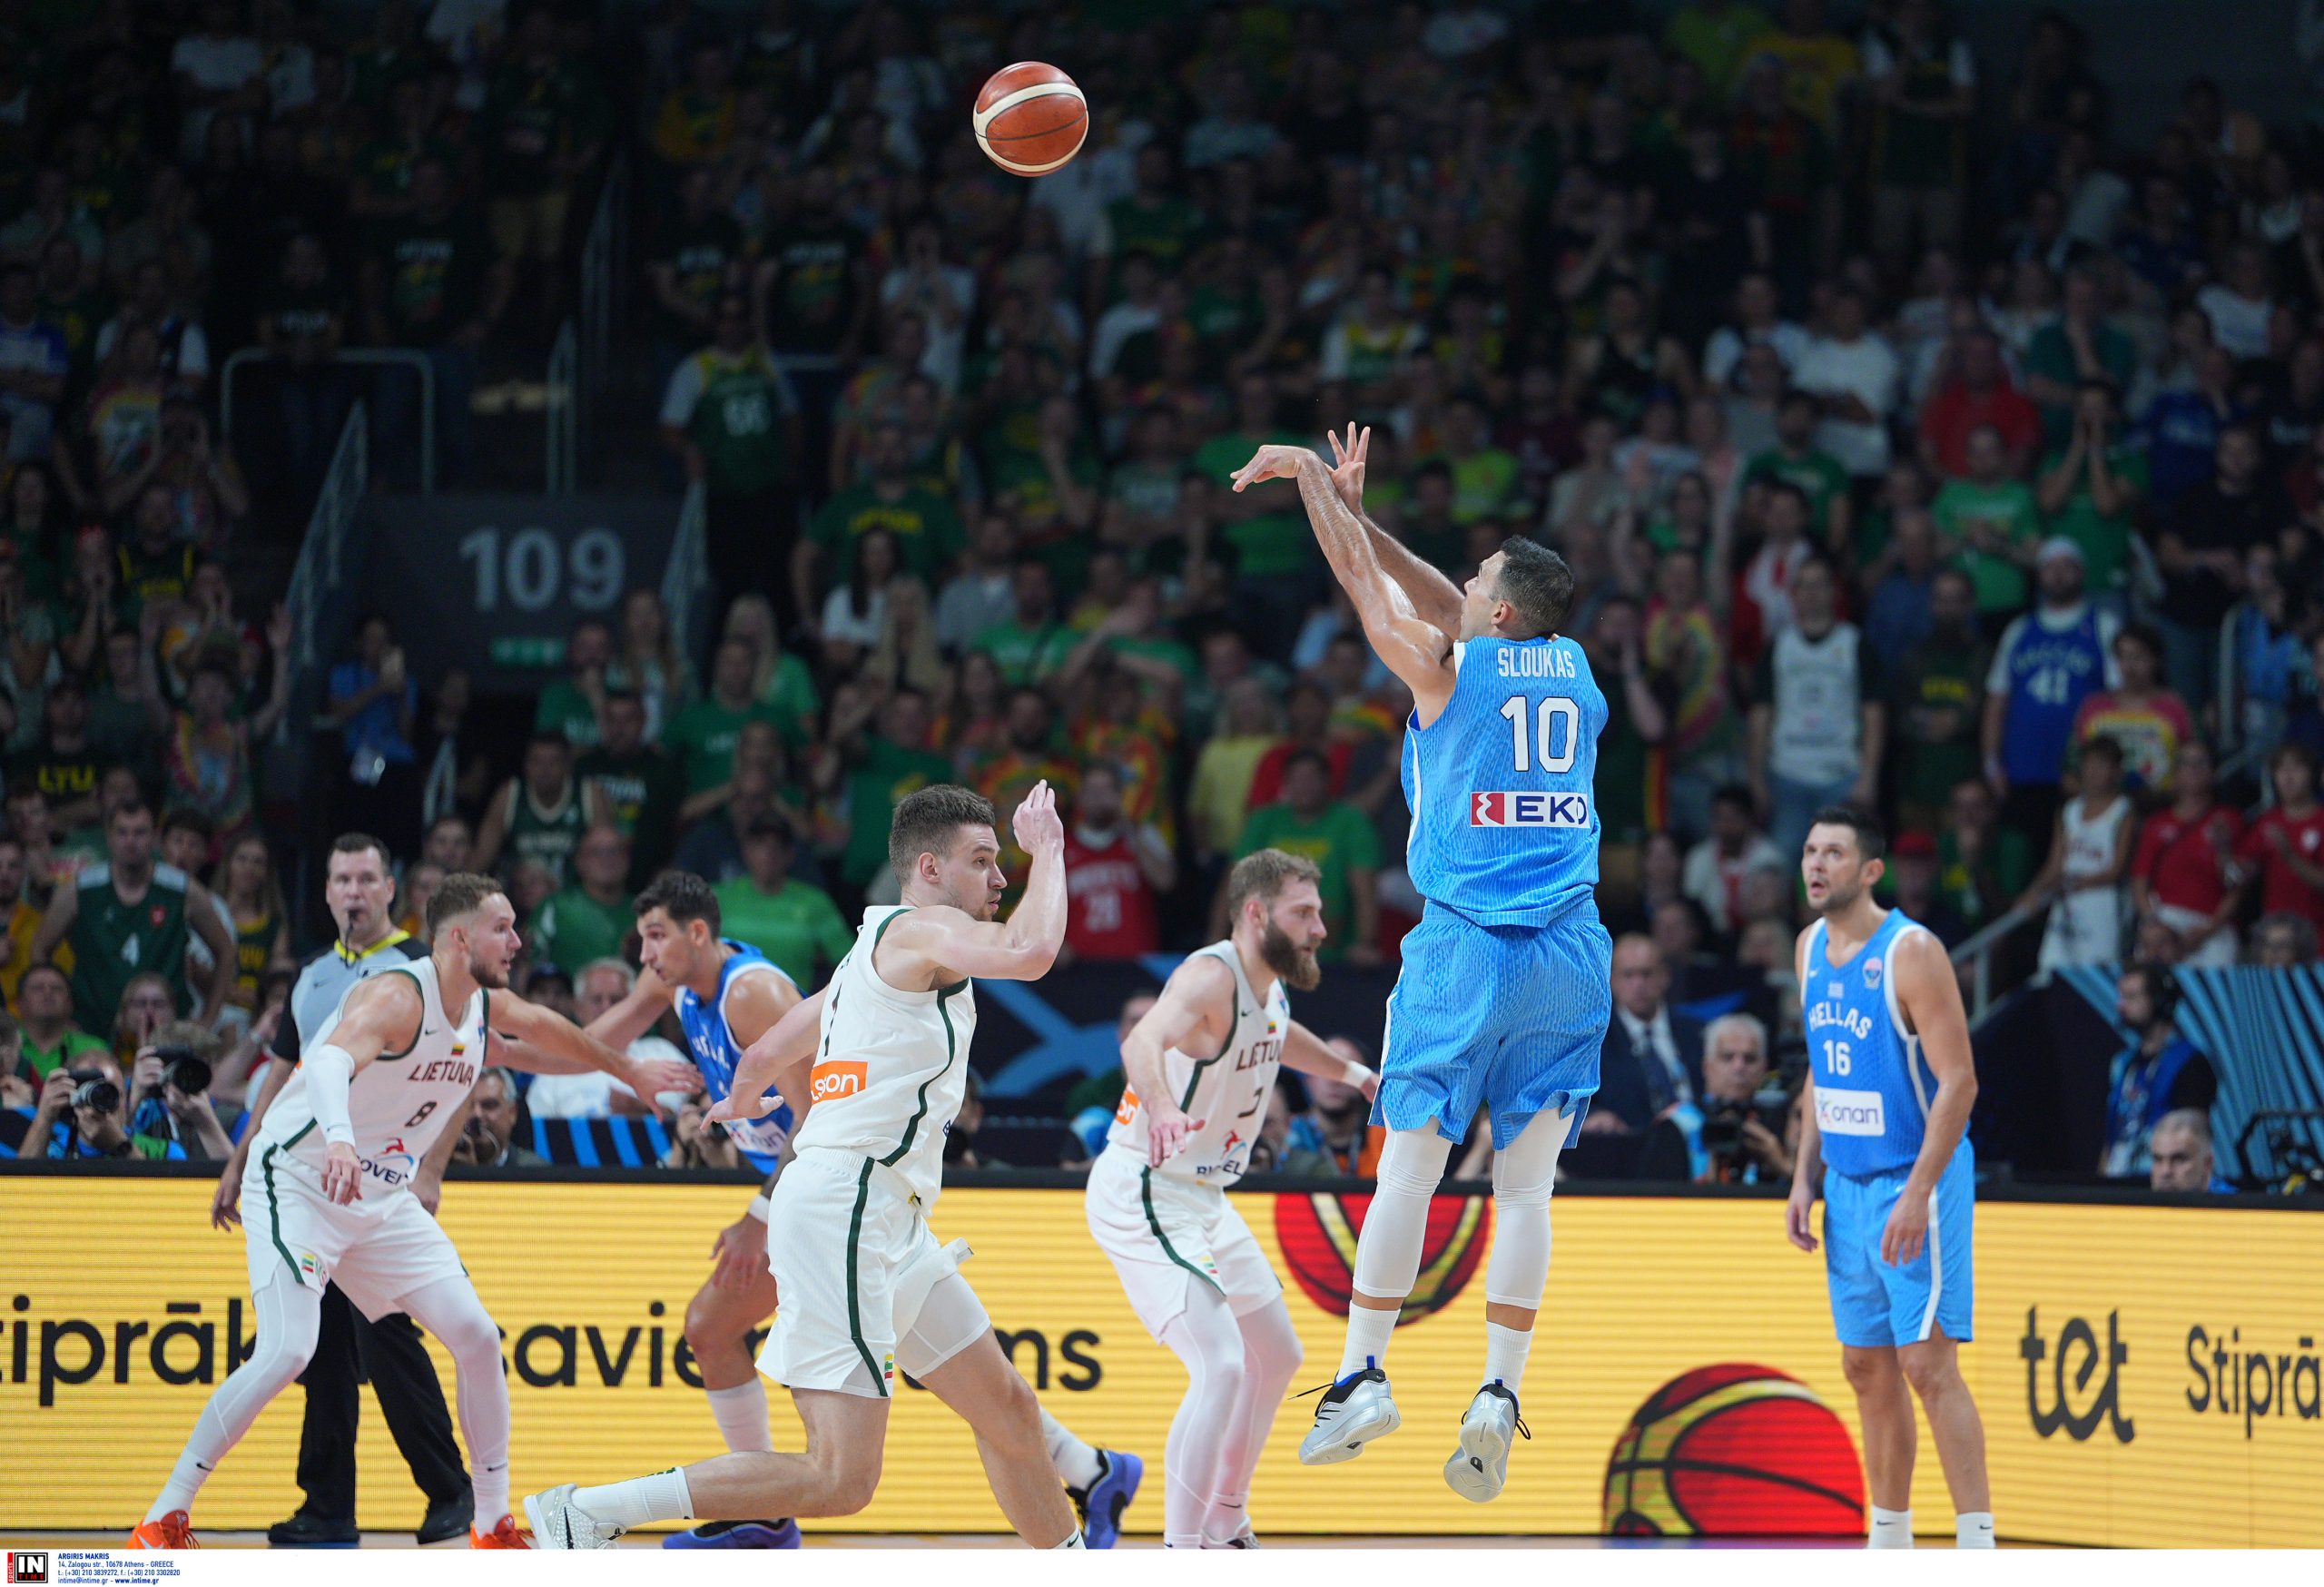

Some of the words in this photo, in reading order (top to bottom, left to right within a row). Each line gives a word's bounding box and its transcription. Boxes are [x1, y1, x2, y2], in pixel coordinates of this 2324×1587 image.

[458, 525, 625, 612] 109
[1497, 647, 1576, 679] SLOUKAS
[1499, 695, 1580, 774] 10
[1807, 1001, 1873, 1040] HELLAS
[408, 1060, 475, 1088] LIETUVA
[1823, 1040, 1851, 1077] 16
[404, 1101, 438, 1128] 8
[2018, 1305, 2135, 1444] tet
